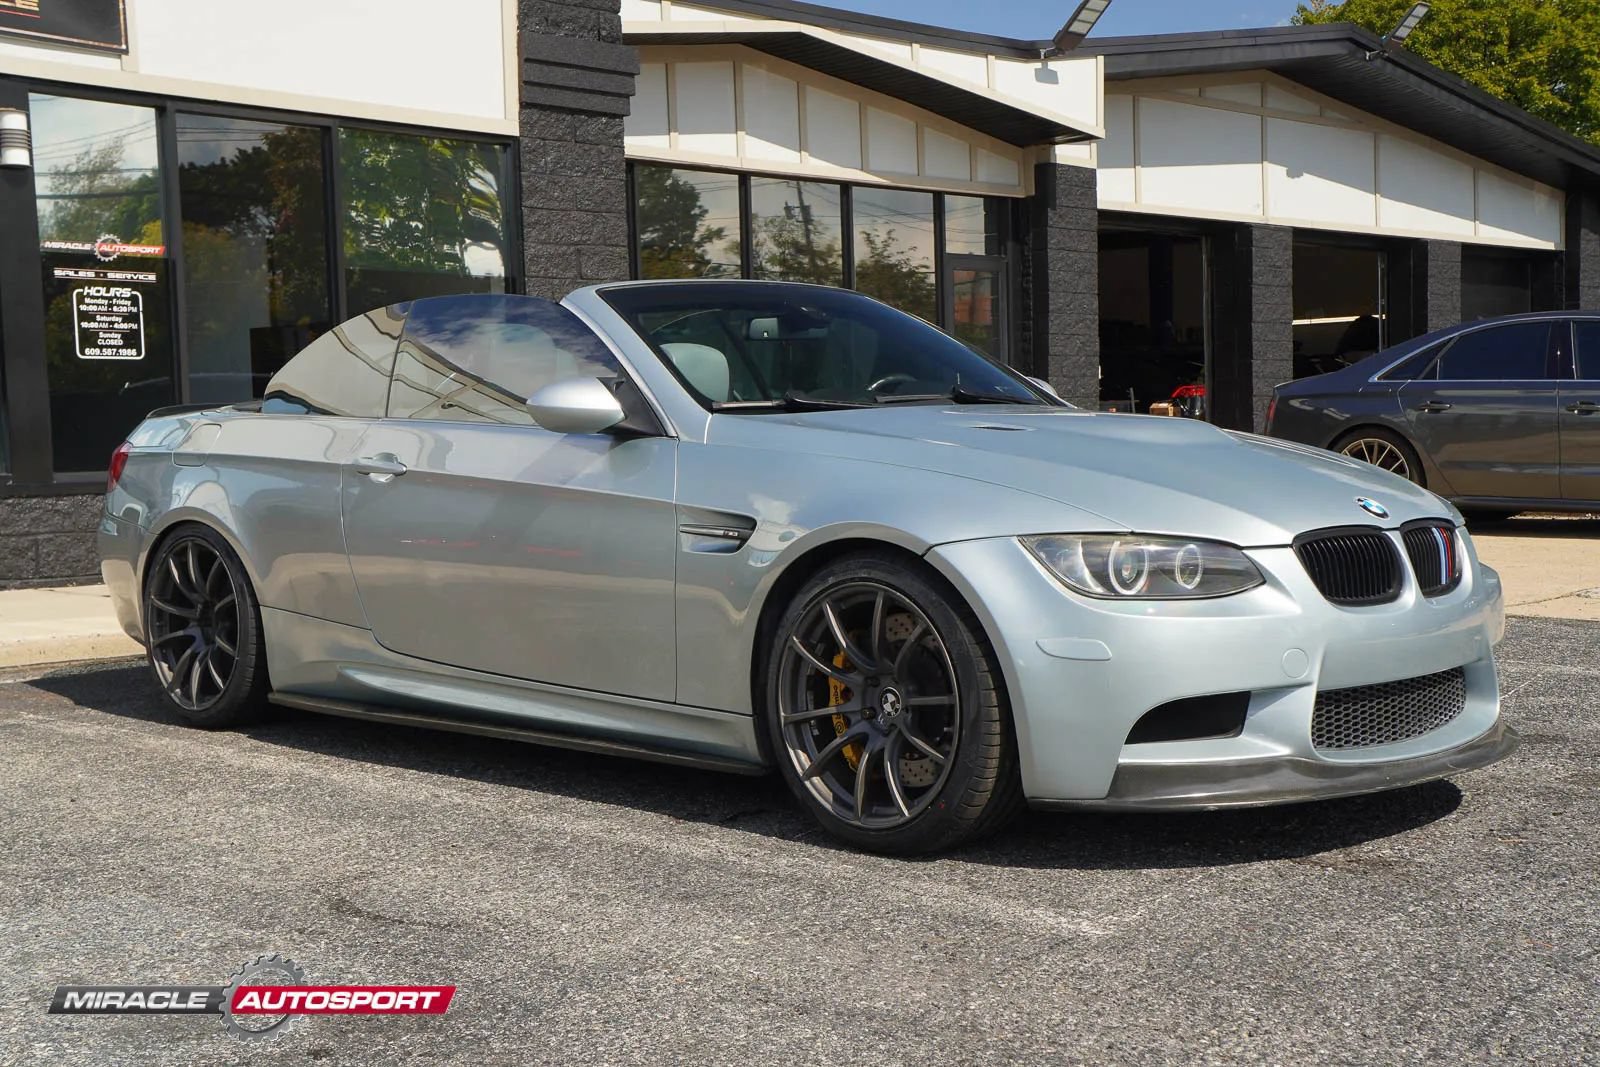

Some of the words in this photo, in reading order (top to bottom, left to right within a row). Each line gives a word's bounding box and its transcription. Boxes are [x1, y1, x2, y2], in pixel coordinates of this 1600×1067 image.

[44, 241, 92, 250] MIRACLE
[99, 244, 161, 254] AUTOSPORT
[54, 269, 96, 278] SALES
[107, 272, 157, 281] SERVICE
[83, 286, 132, 297] HOURS
[84, 297, 108, 305] Monday
[113, 298, 132, 306] Friday
[96, 315, 122, 323] Saturday
[98, 331, 121, 339] Sunday
[84, 347, 137, 356] 609.587.1986
